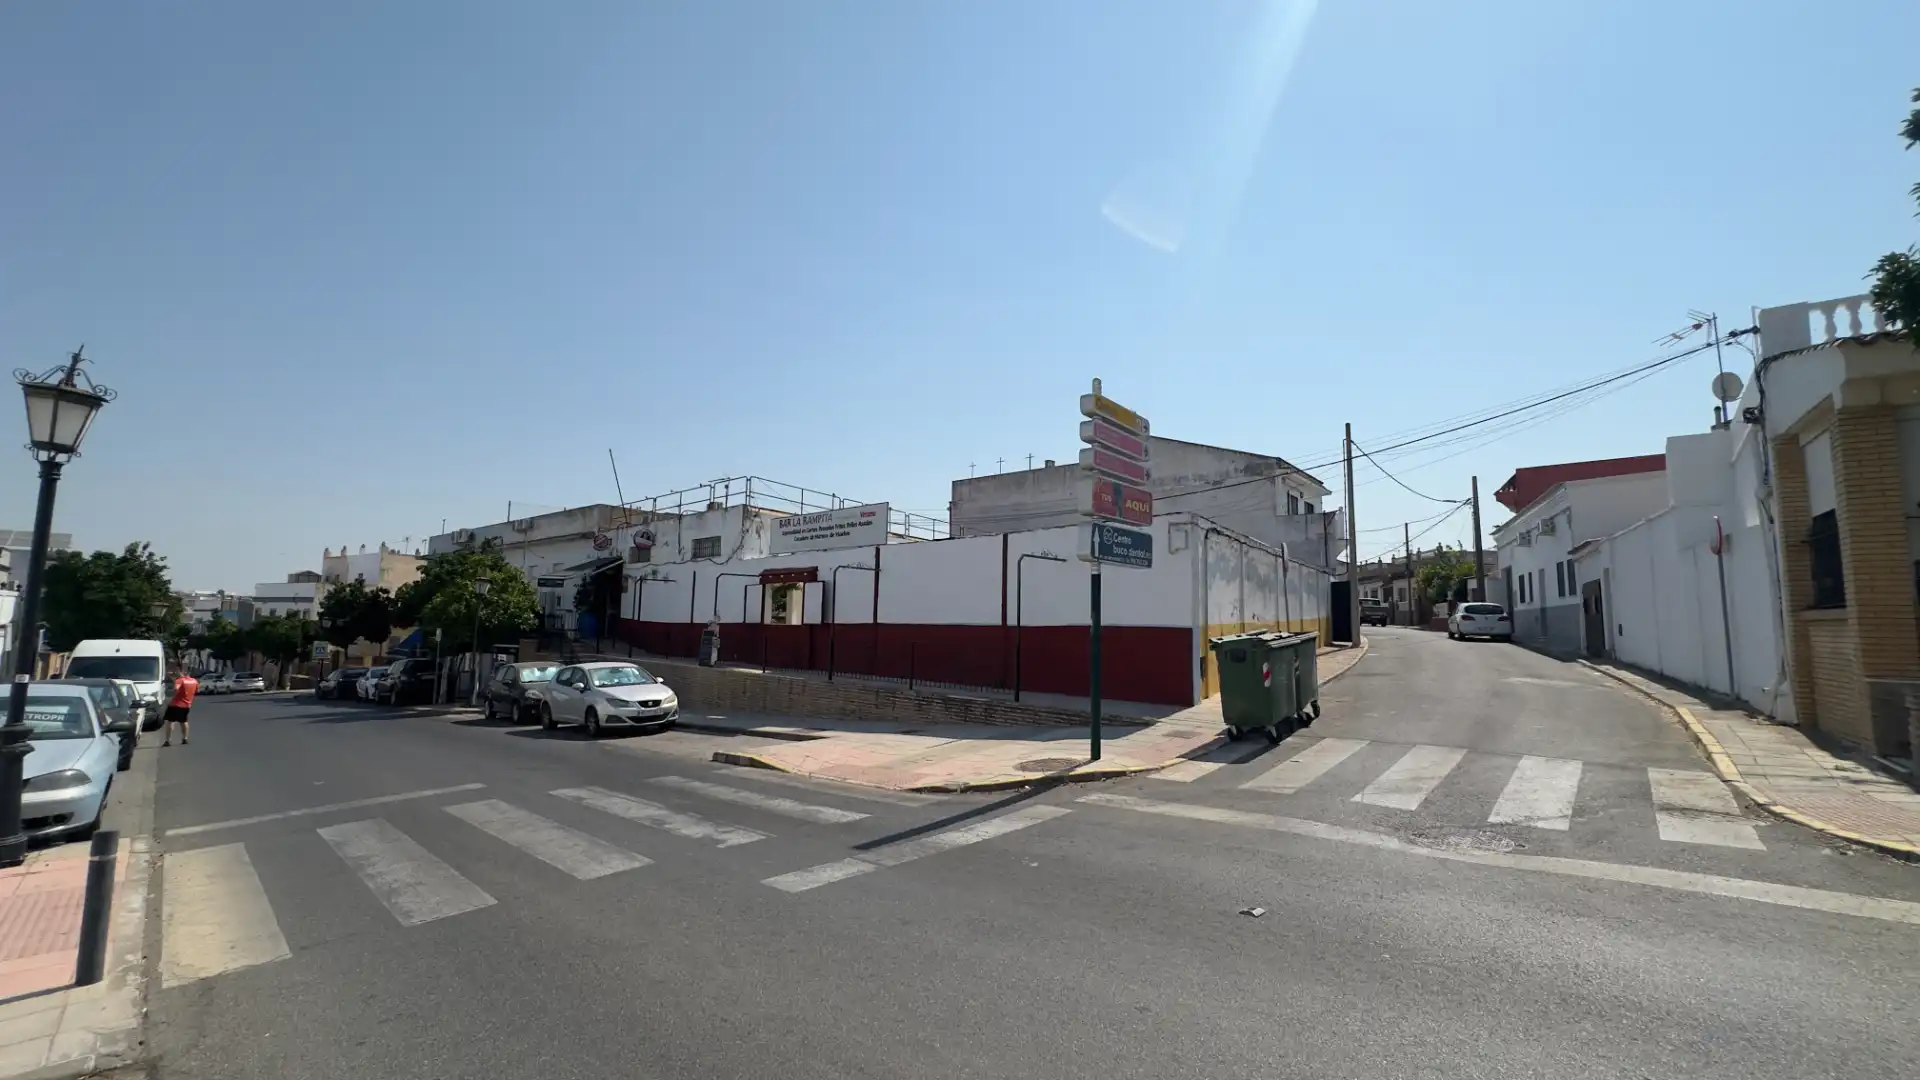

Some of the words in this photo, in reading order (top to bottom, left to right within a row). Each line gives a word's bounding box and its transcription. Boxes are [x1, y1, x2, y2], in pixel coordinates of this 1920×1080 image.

[779, 518, 791, 528] BAR
[792, 517, 801, 527] LA
[803, 513, 833, 526] RAMPITA
[1113, 532, 1132, 544] Centro
[1113, 544, 1127, 555] buco
